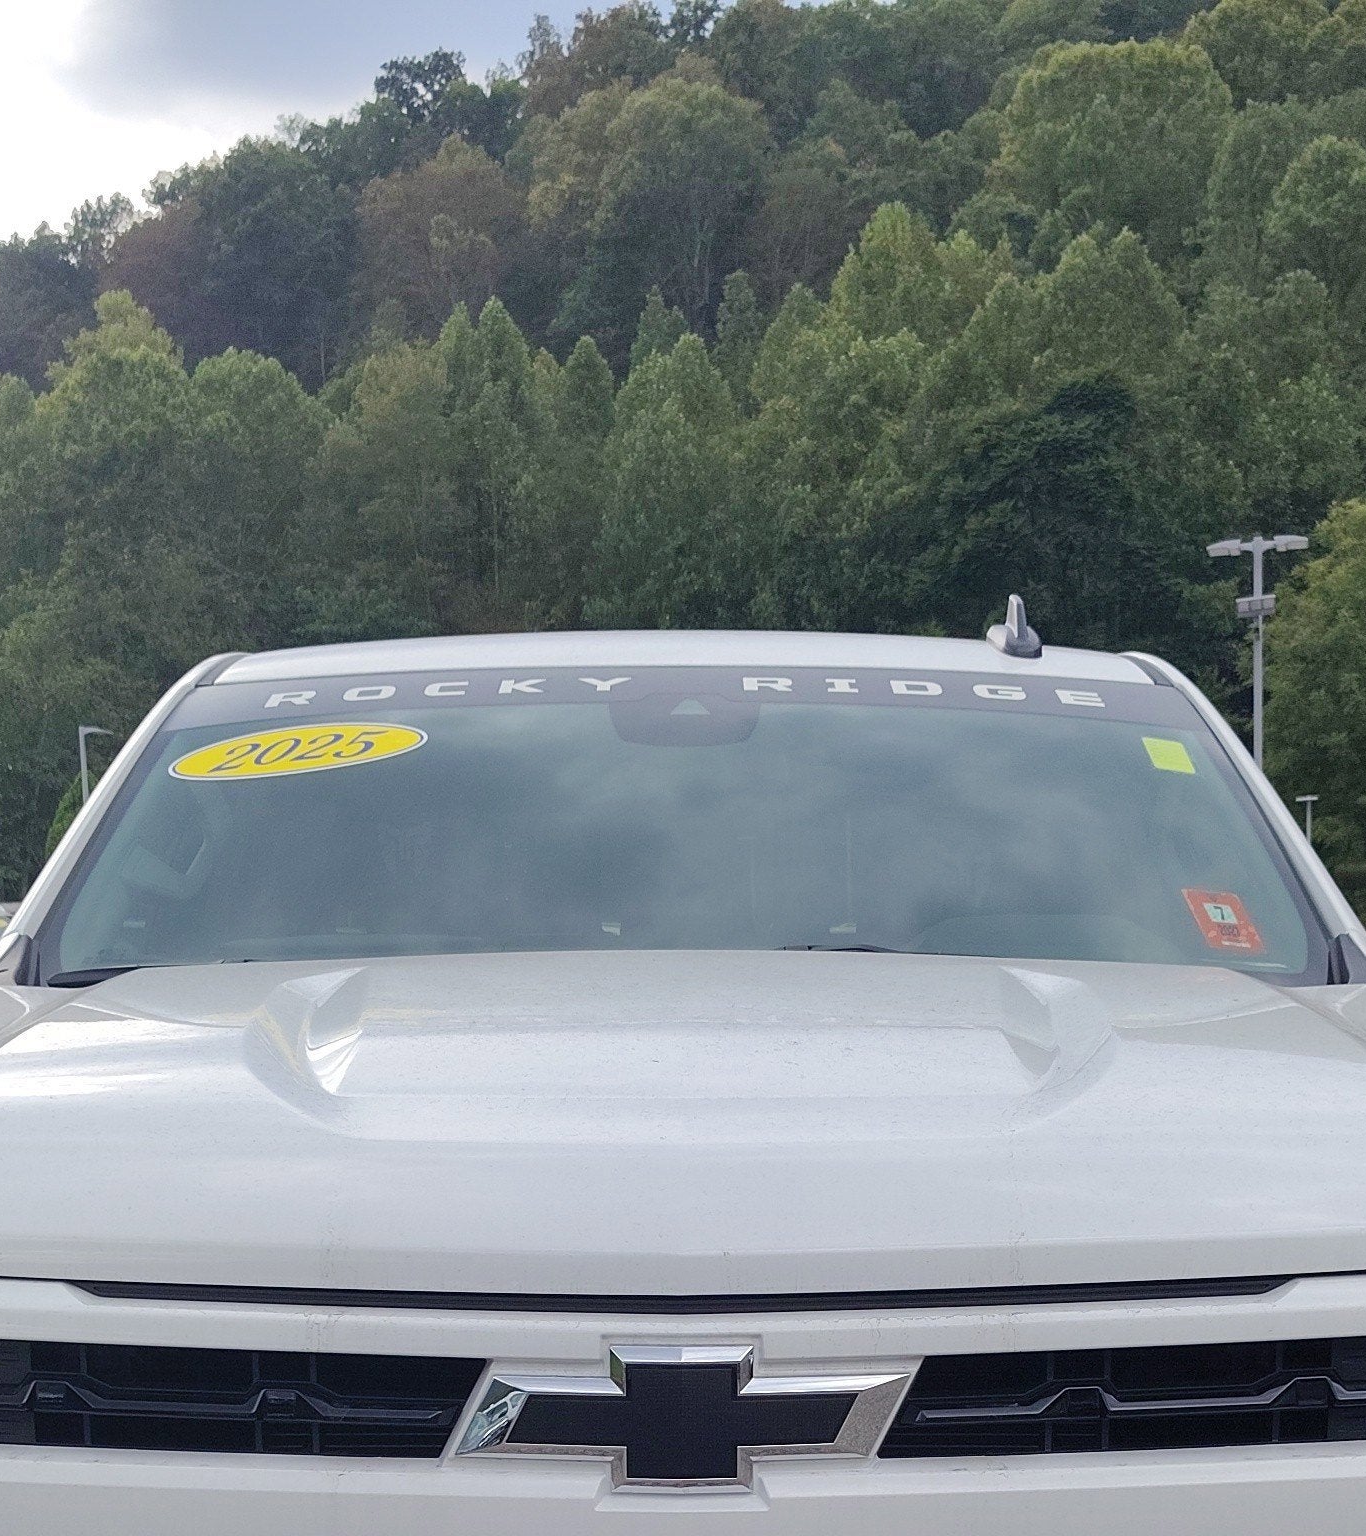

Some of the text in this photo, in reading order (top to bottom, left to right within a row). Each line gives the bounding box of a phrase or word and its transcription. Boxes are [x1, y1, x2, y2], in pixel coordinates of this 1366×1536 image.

[264, 676, 1106, 709] ROCKY RIDGE
[208, 731, 389, 774] 2025
[1213, 905, 1225, 920] 7
